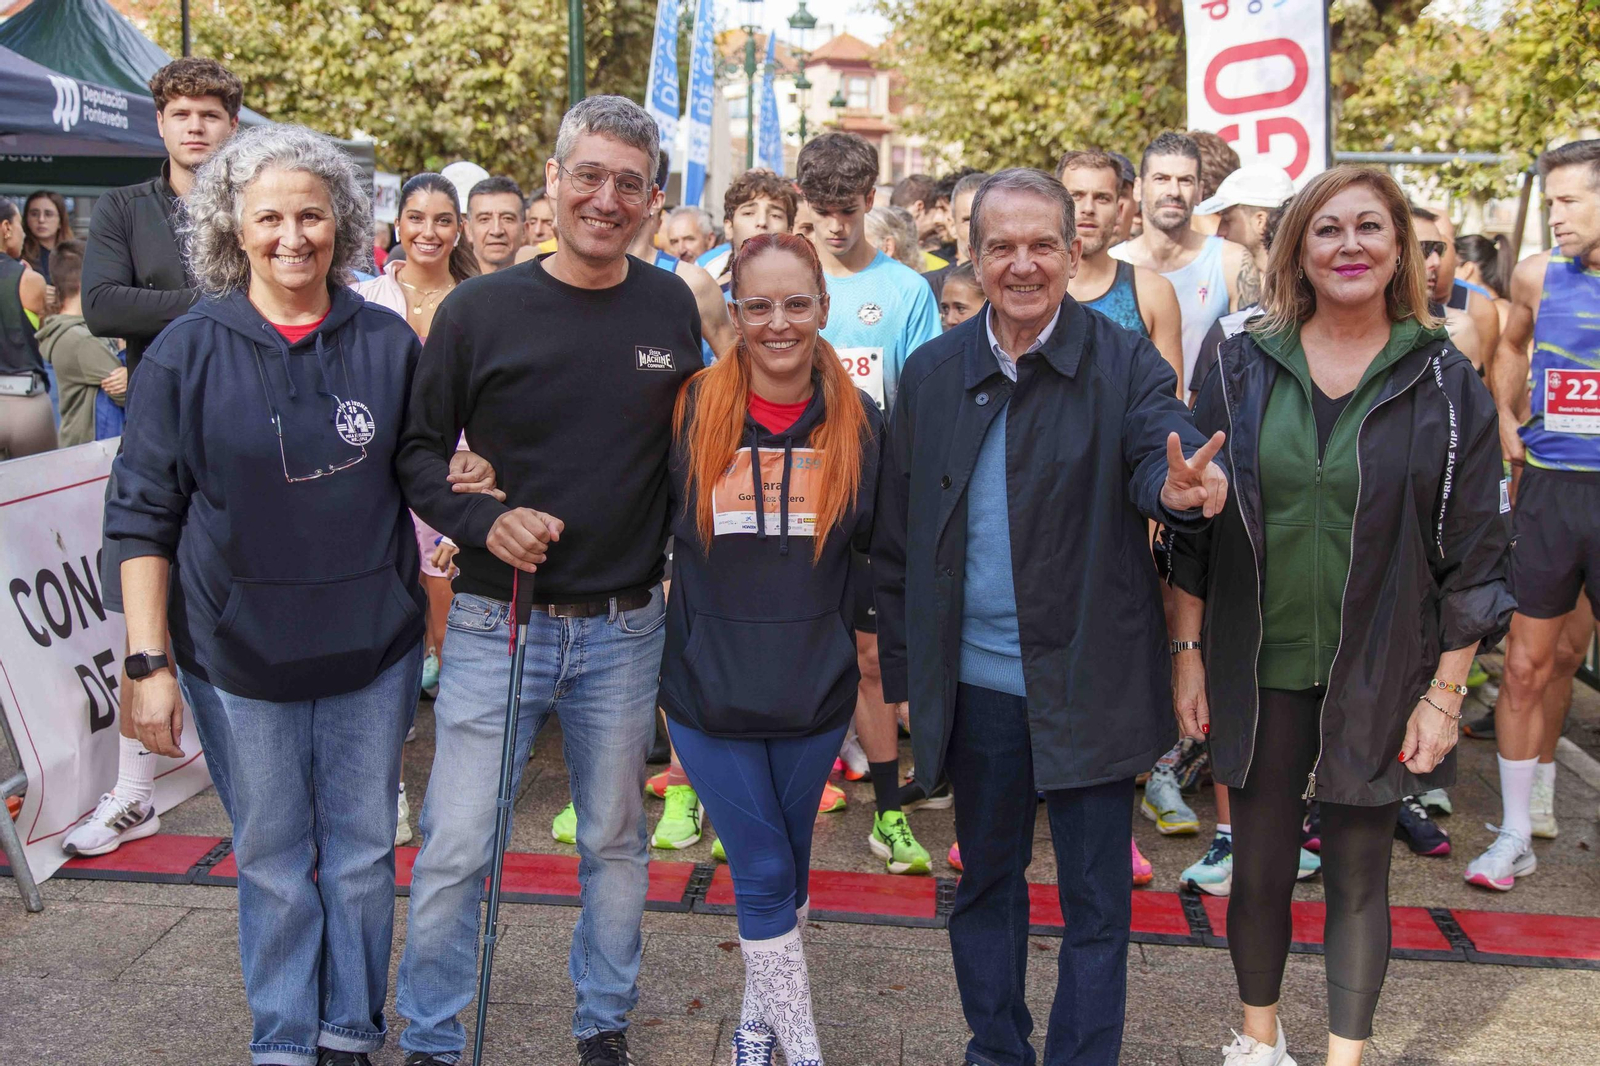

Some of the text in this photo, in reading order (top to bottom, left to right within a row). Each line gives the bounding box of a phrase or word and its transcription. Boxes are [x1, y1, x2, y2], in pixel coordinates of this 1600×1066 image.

[83, 104, 129, 130] Pontevedra
[638, 350, 673, 369] MACHINE
[1565, 378, 1600, 401] 22
[1449, 401, 1457, 427] PRIV
[1449, 430, 1458, 449] VIP
[761, 482, 783, 491] ara
[1443, 452, 1455, 499] PRIVATE
[738, 493, 777, 502] Gonlez
[9, 548, 107, 648] CON
